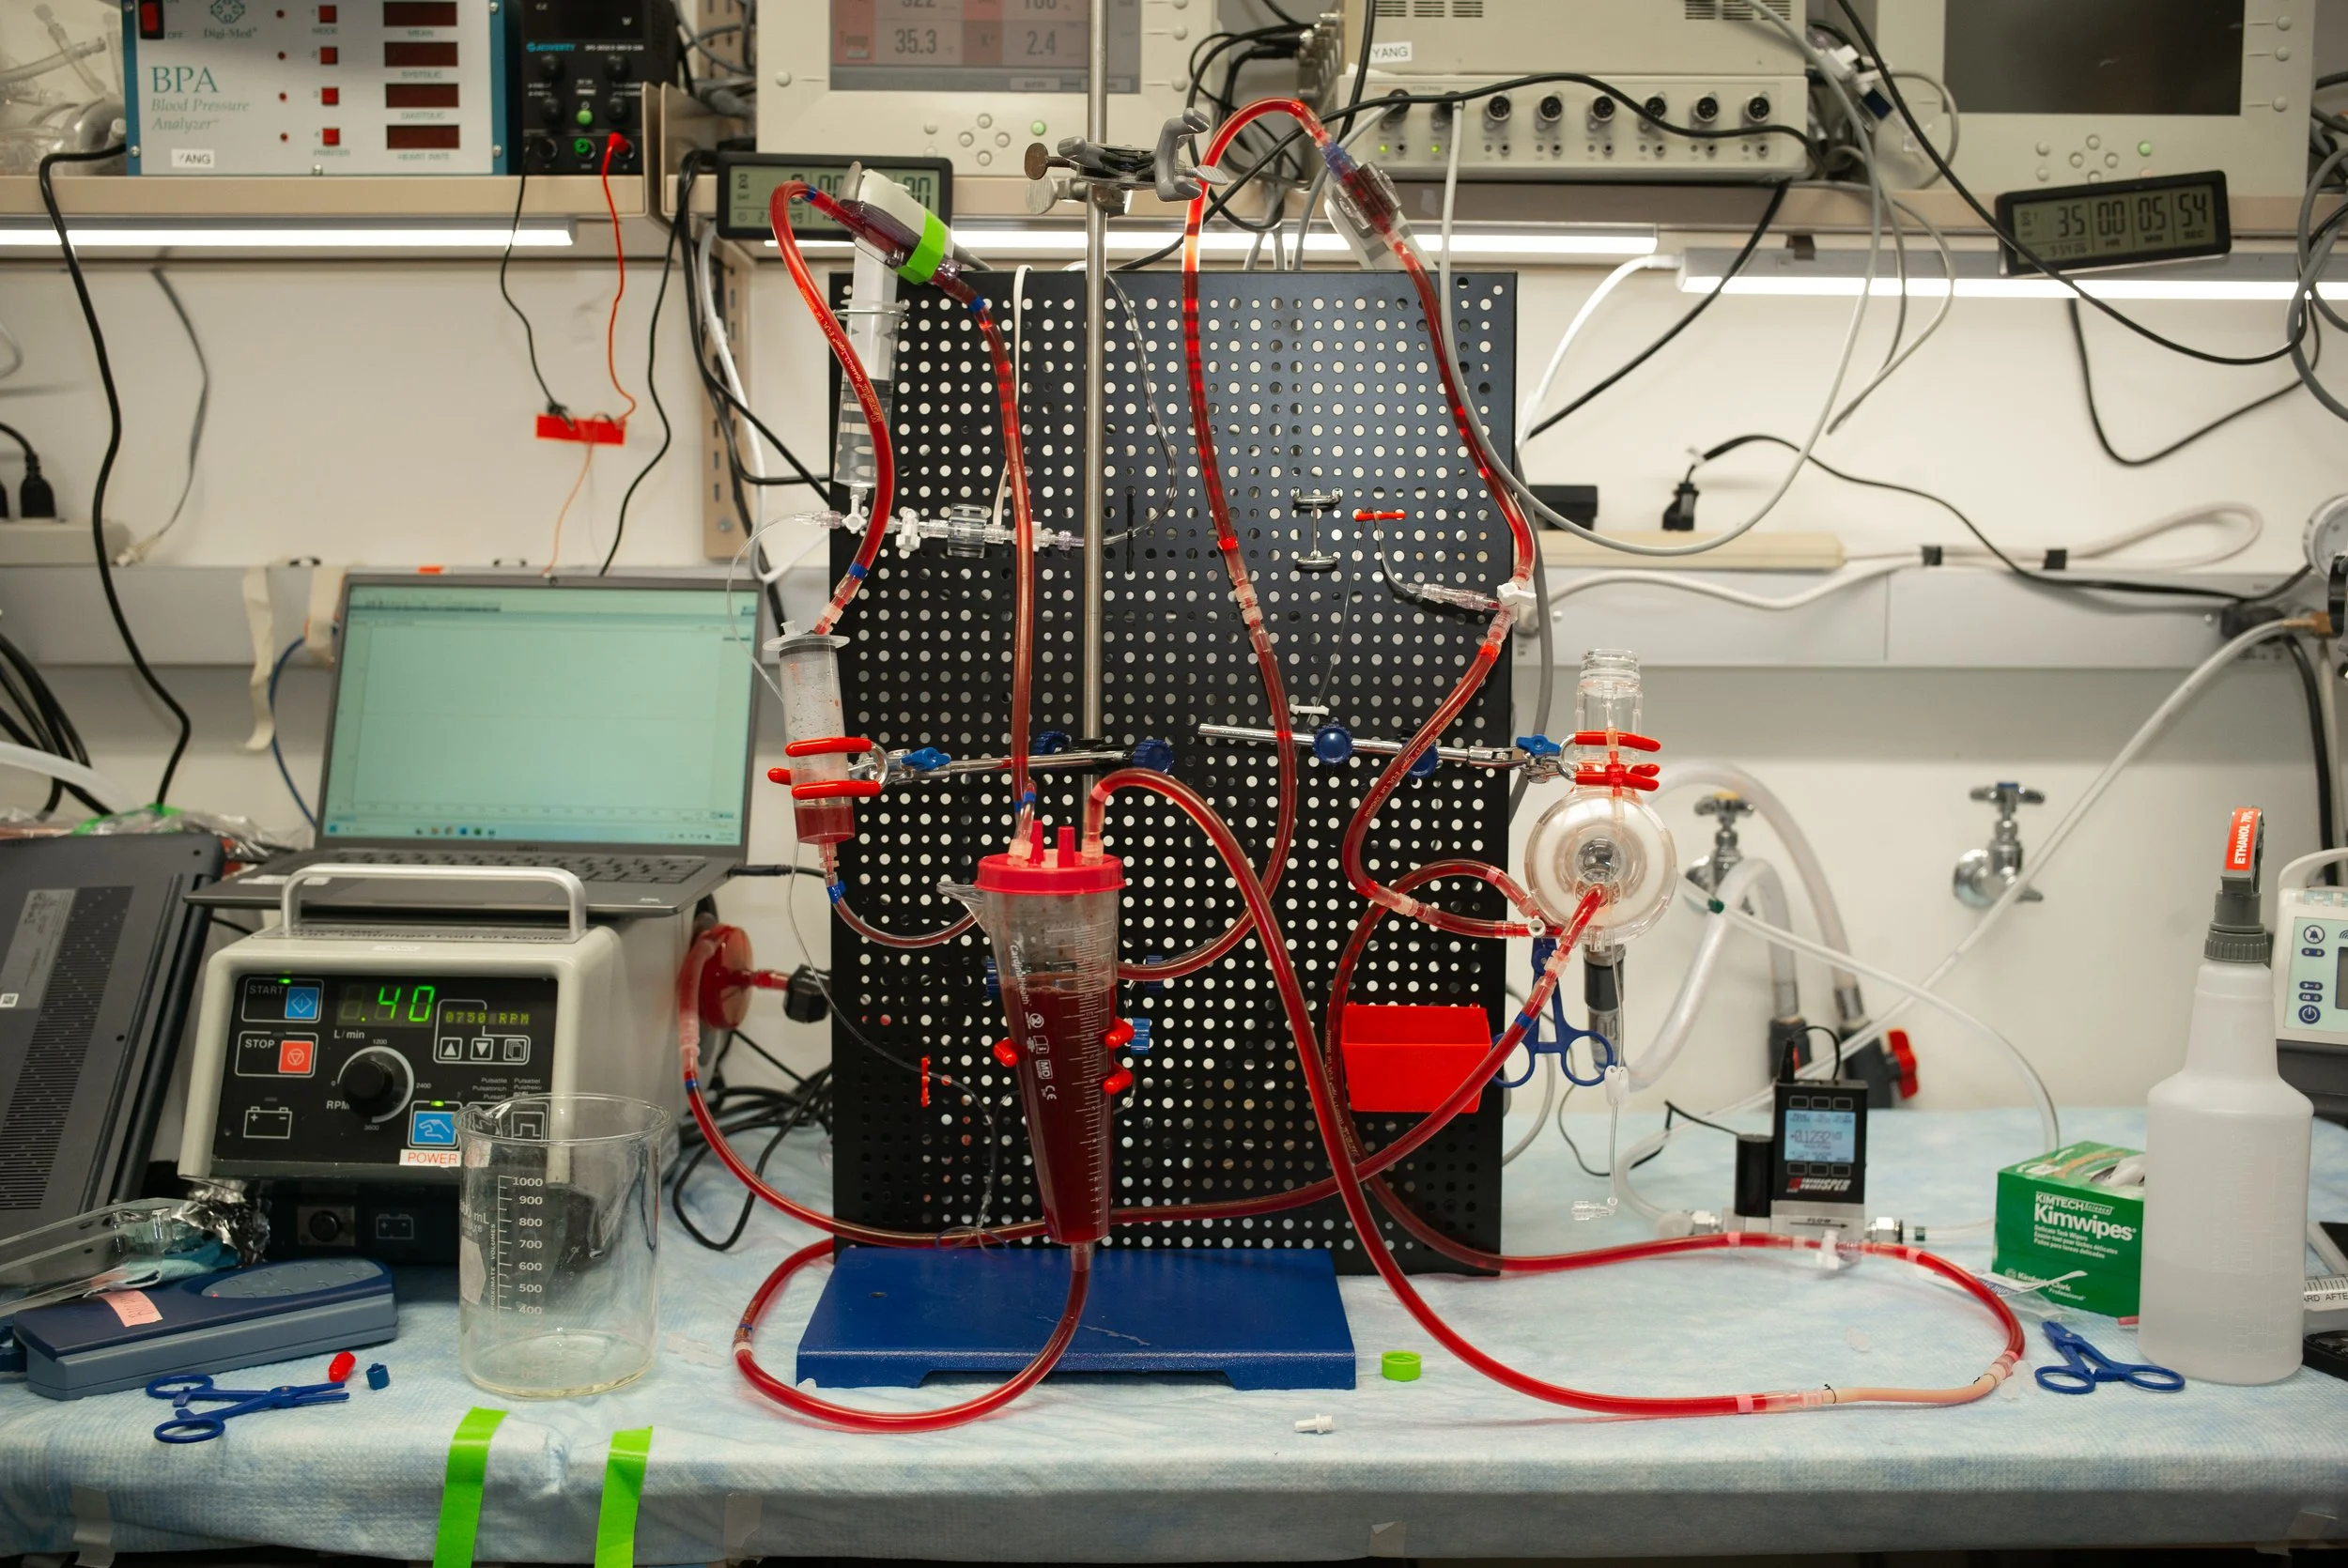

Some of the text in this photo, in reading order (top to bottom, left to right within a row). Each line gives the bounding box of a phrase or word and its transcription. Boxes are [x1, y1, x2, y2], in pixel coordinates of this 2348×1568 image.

[895, 29, 937, 54] 35.3
[1027, 31, 1056, 55] 2.4
[1372, 46, 1409, 59] YANG
[150, 65, 219, 93] BPA
[150, 98, 249, 113] Blood Pressure
[178, 153, 211, 164] YANG
[2058, 193, 2208, 237] 35 00 05 54
[2233, 824, 2251, 865] ETHANOL
[249, 985, 284, 995] START
[499, 1013, 530, 1025] RPM
[244, 1038, 275, 1049] STOP
[1040, 1060, 1051, 1078] MD
[407, 1152, 458, 1165] POWER
[512, 1177, 544, 1187] 1000
[1799, 1177, 1852, 1192] WHISPER
[518, 1196, 543, 1205] 900
[2035, 1192, 2111, 1215] KIMTECH Science
[518, 1218, 543, 1227] 800
[2034, 1224, 2057, 1236] Delicate
[2069, 1232, 2088, 1242] Wipers
[518, 1240, 543, 1249] 700
[518, 1262, 543, 1271] 600
[518, 1284, 543, 1293] 500
[518, 1306, 543, 1315] 400
